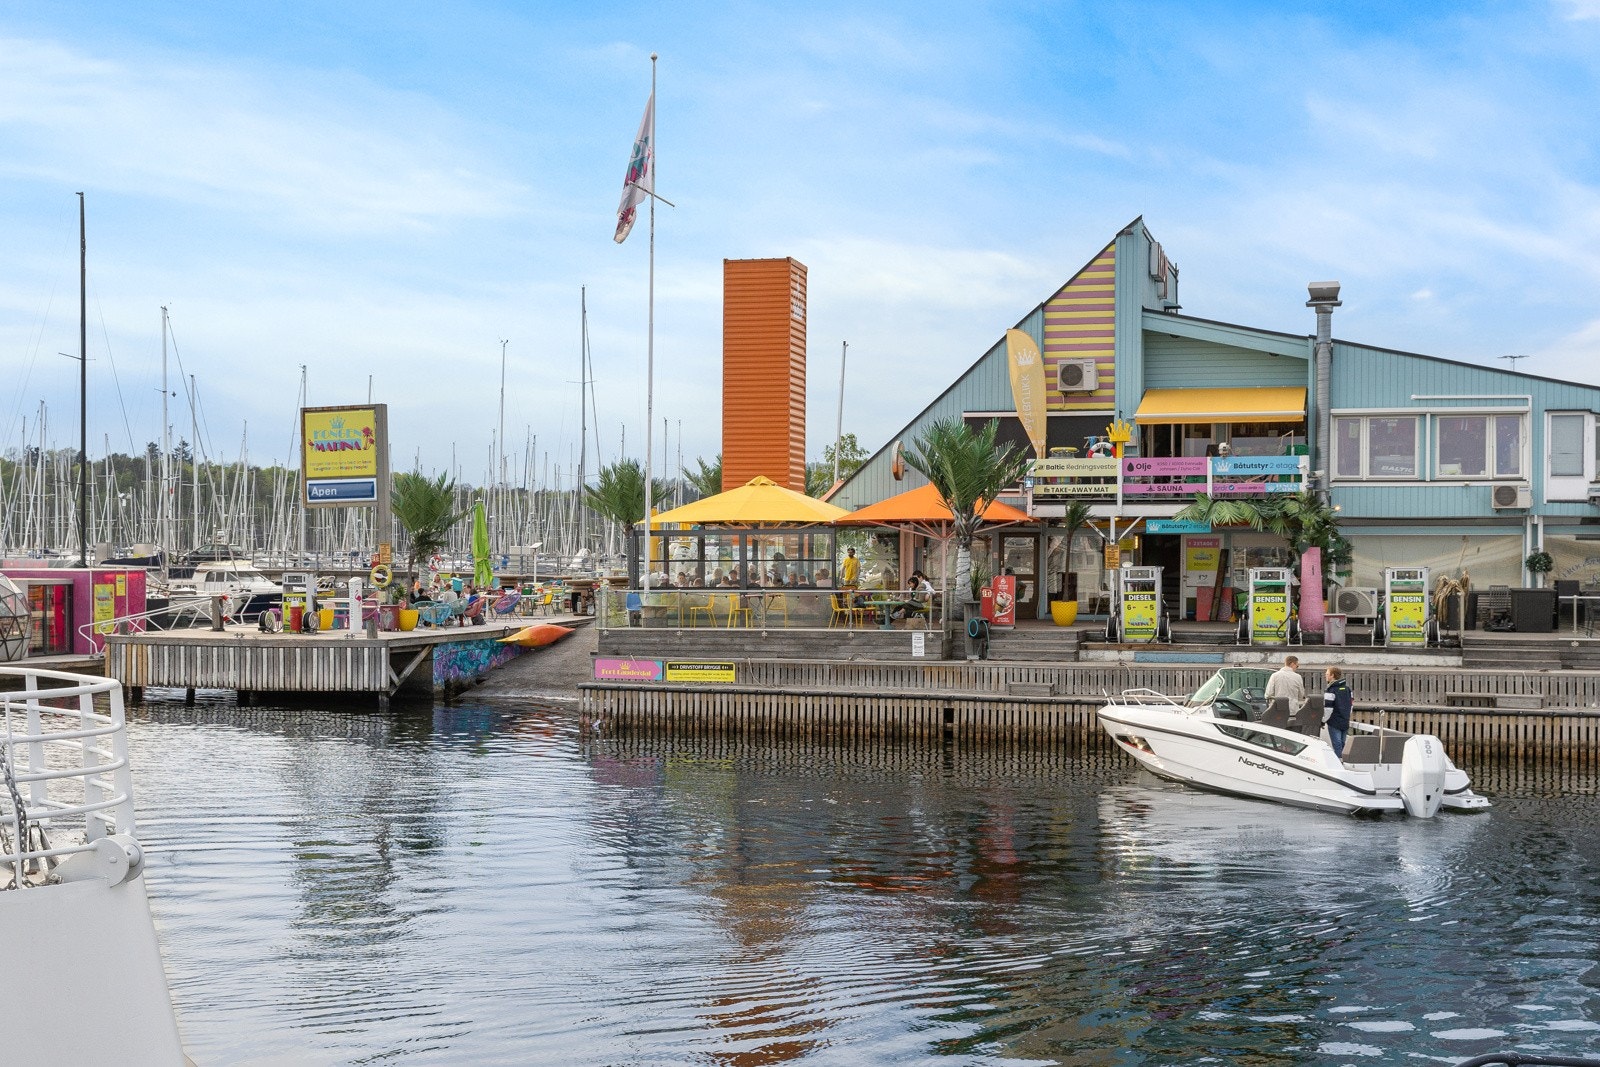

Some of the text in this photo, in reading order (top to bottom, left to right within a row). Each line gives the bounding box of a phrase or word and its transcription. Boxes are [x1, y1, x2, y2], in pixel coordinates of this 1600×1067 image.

[313, 428, 362, 440] KONGEN
[314, 440, 362, 452] MARINA
[1066, 463, 1117, 471] Redningsvester
[1136, 463, 1152, 471] Olje
[1233, 462, 1269, 470] Båtutstyr
[1381, 465, 1413, 473] BALTIC
